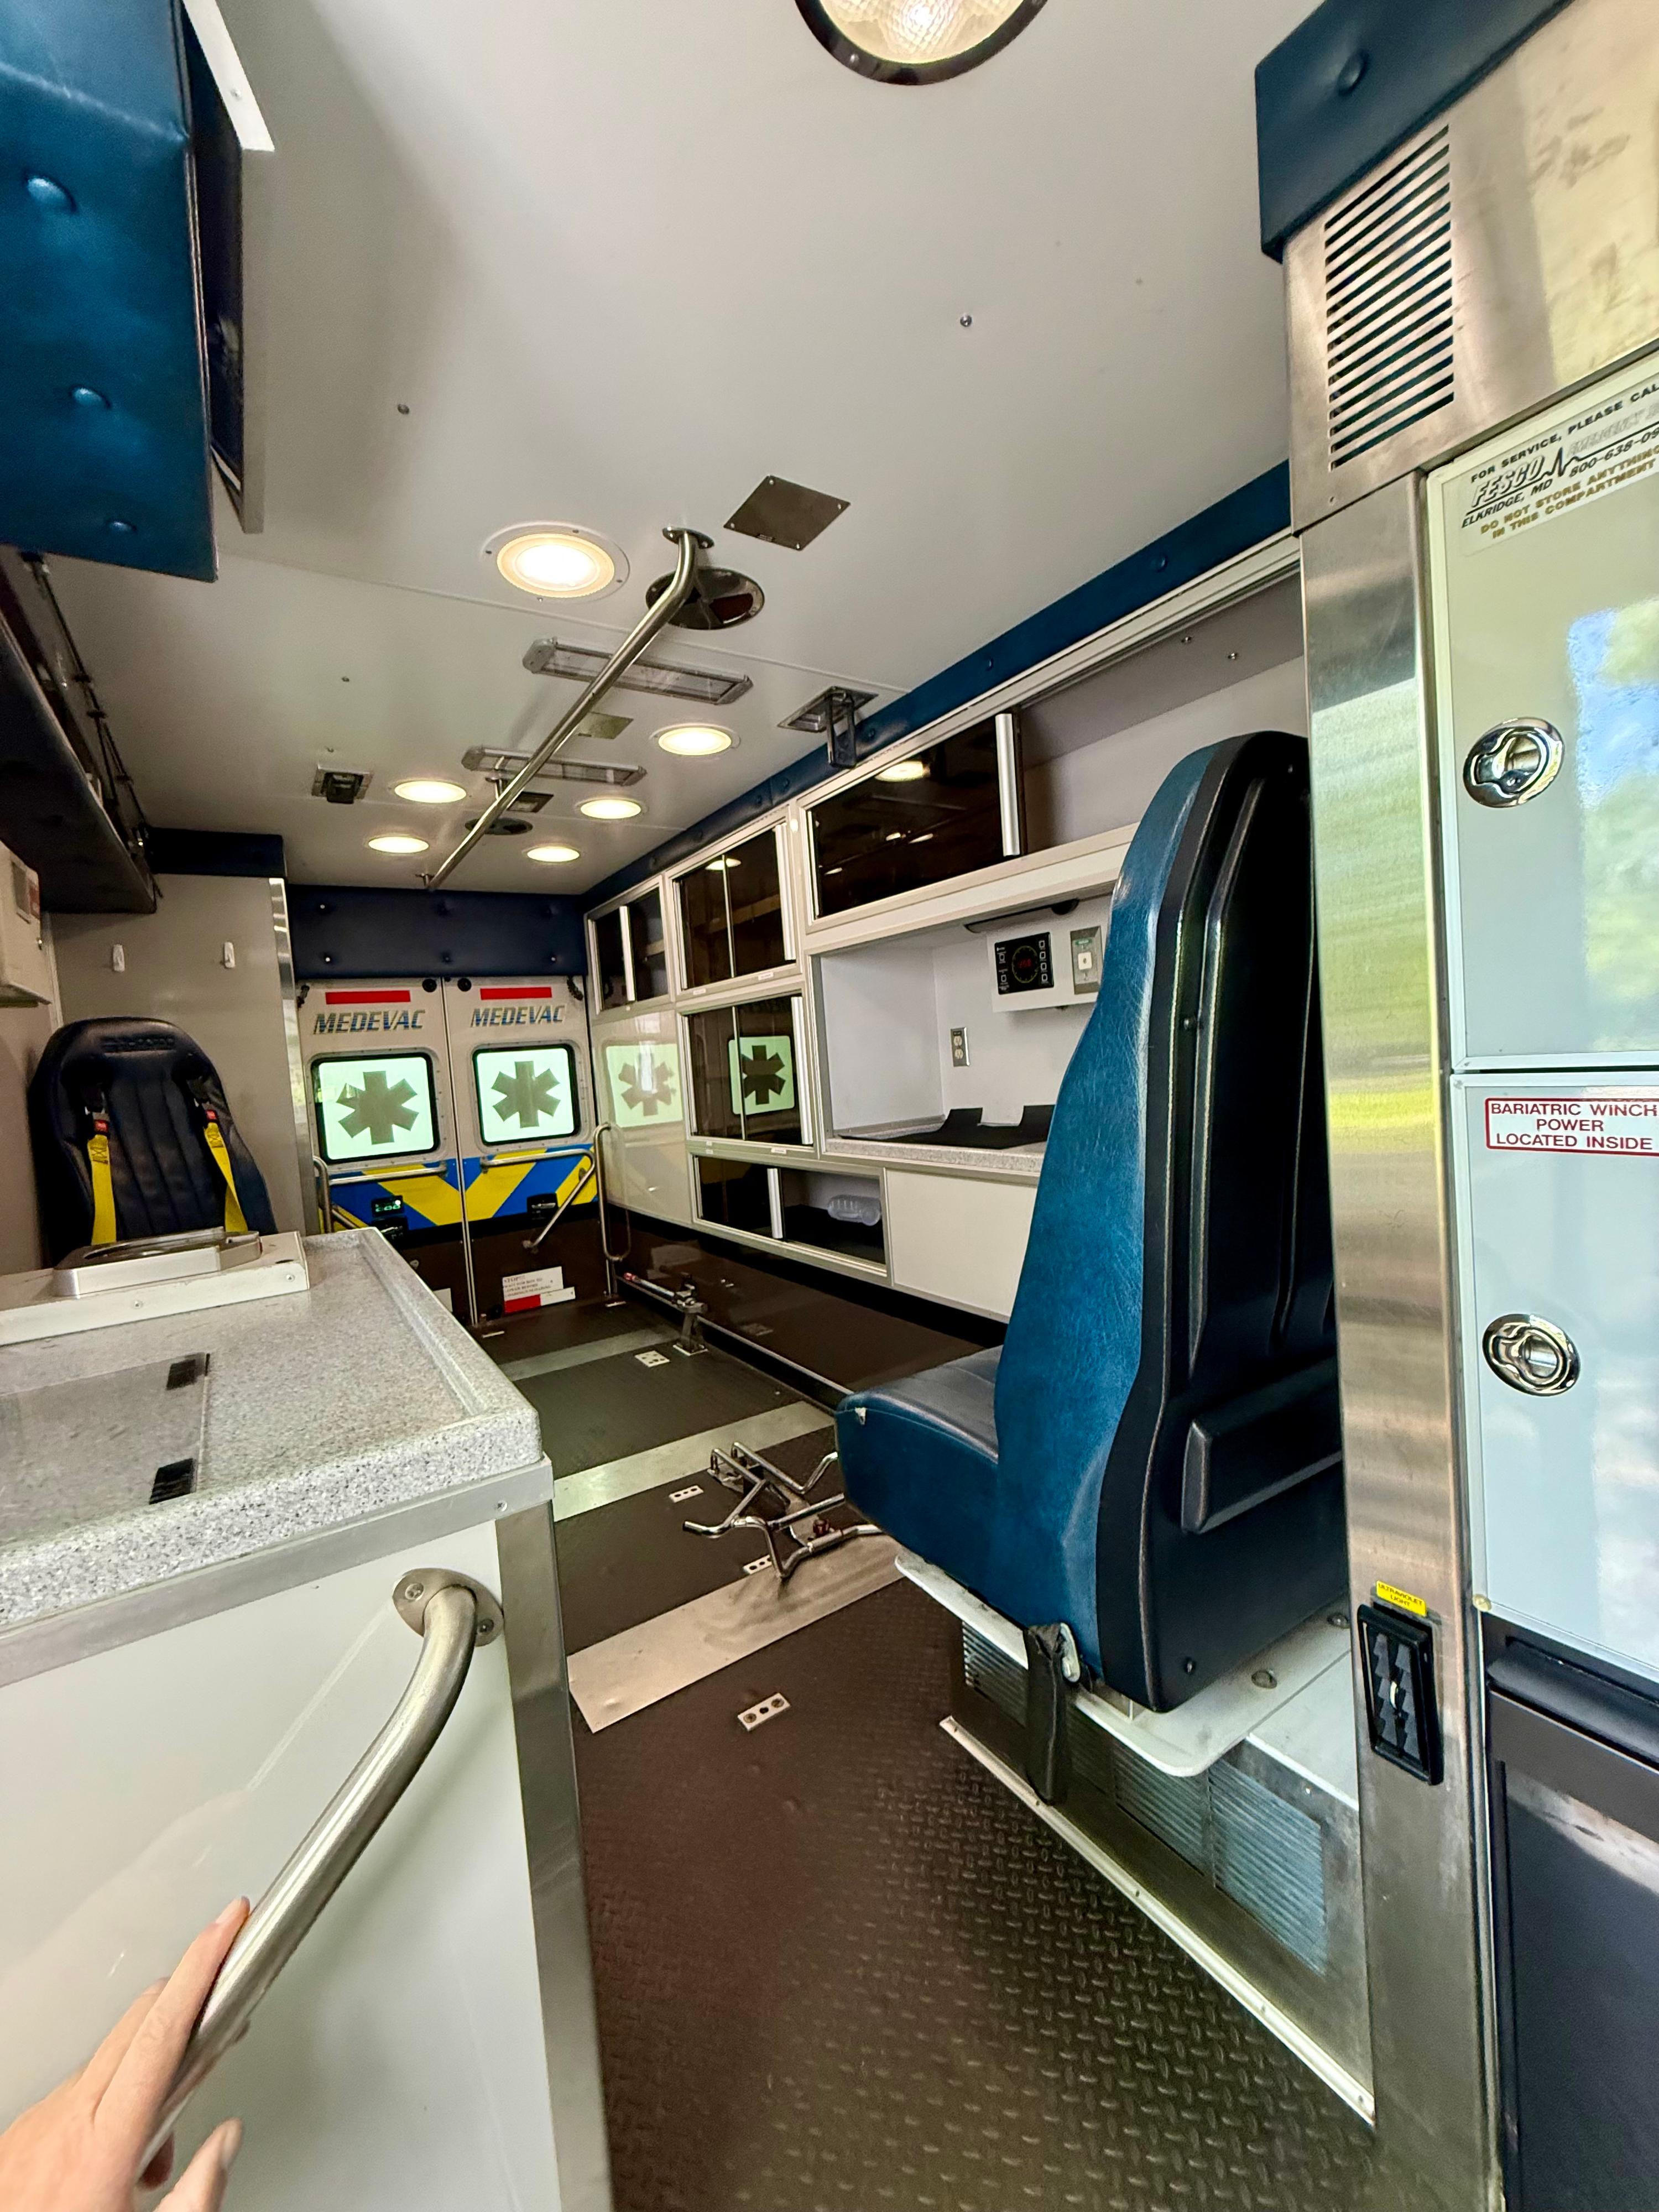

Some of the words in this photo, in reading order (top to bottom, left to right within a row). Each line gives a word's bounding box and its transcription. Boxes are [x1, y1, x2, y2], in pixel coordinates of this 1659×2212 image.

[1471, 465, 1495, 483] FOR
[1501, 434, 1562, 468] SERVICE,
[1568, 400, 1623, 435] PLEASE
[1462, 492, 1525, 528] ELKRIDGE,
[1531, 478, 1553, 495] MD
[1481, 520, 1499, 535] DO
[1504, 504, 1530, 523] NOT
[1535, 482, 1580, 508] STORE
[1493, 527, 1505, 539] IN
[1510, 512, 1538, 530] THIS
[1545, 458, 1656, 514] COMPARTMENT
[313, 1009, 425, 1035] MEDEVAC
[470, 1005, 566, 1028] MEDEVAC
[1491, 1103, 1582, 1115] BARIATRIC
[1590, 1104, 1658, 1117] WINCH
[1536, 1119, 1604, 1131] POWER
[1496, 1133, 1577, 1147] LOCATED
[1587, 1136, 1653, 1150] INSIDE
[1378, 1583, 1422, 1606] ULTRAVIOLET
[1390, 1594, 1410, 1606] LIGHT
